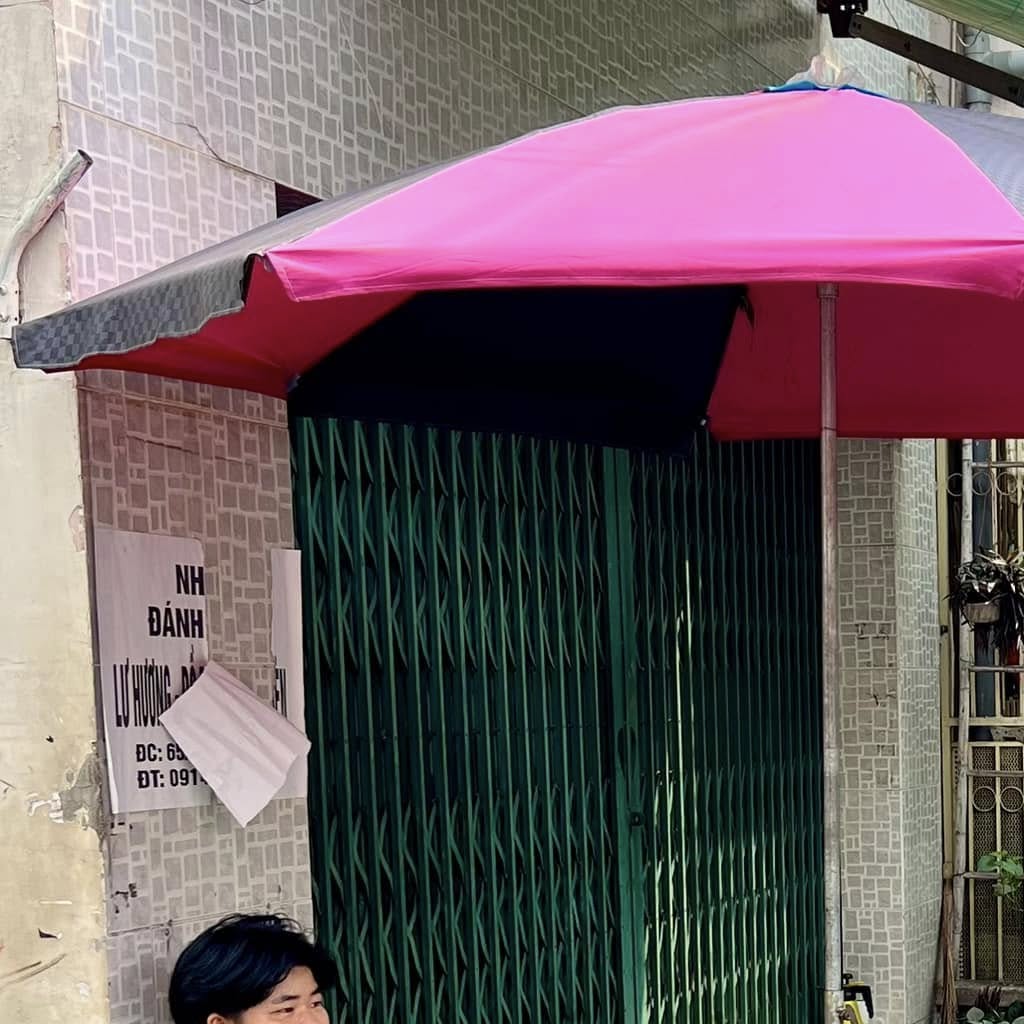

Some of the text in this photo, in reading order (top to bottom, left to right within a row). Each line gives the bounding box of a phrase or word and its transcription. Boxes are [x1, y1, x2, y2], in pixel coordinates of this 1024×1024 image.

[175, 565, 205, 596] NH
[148, 601, 205, 638] ĐÁNH
[136, 742, 188, 762] ĐC: 65
[138, 769, 164, 789] ĐT:
